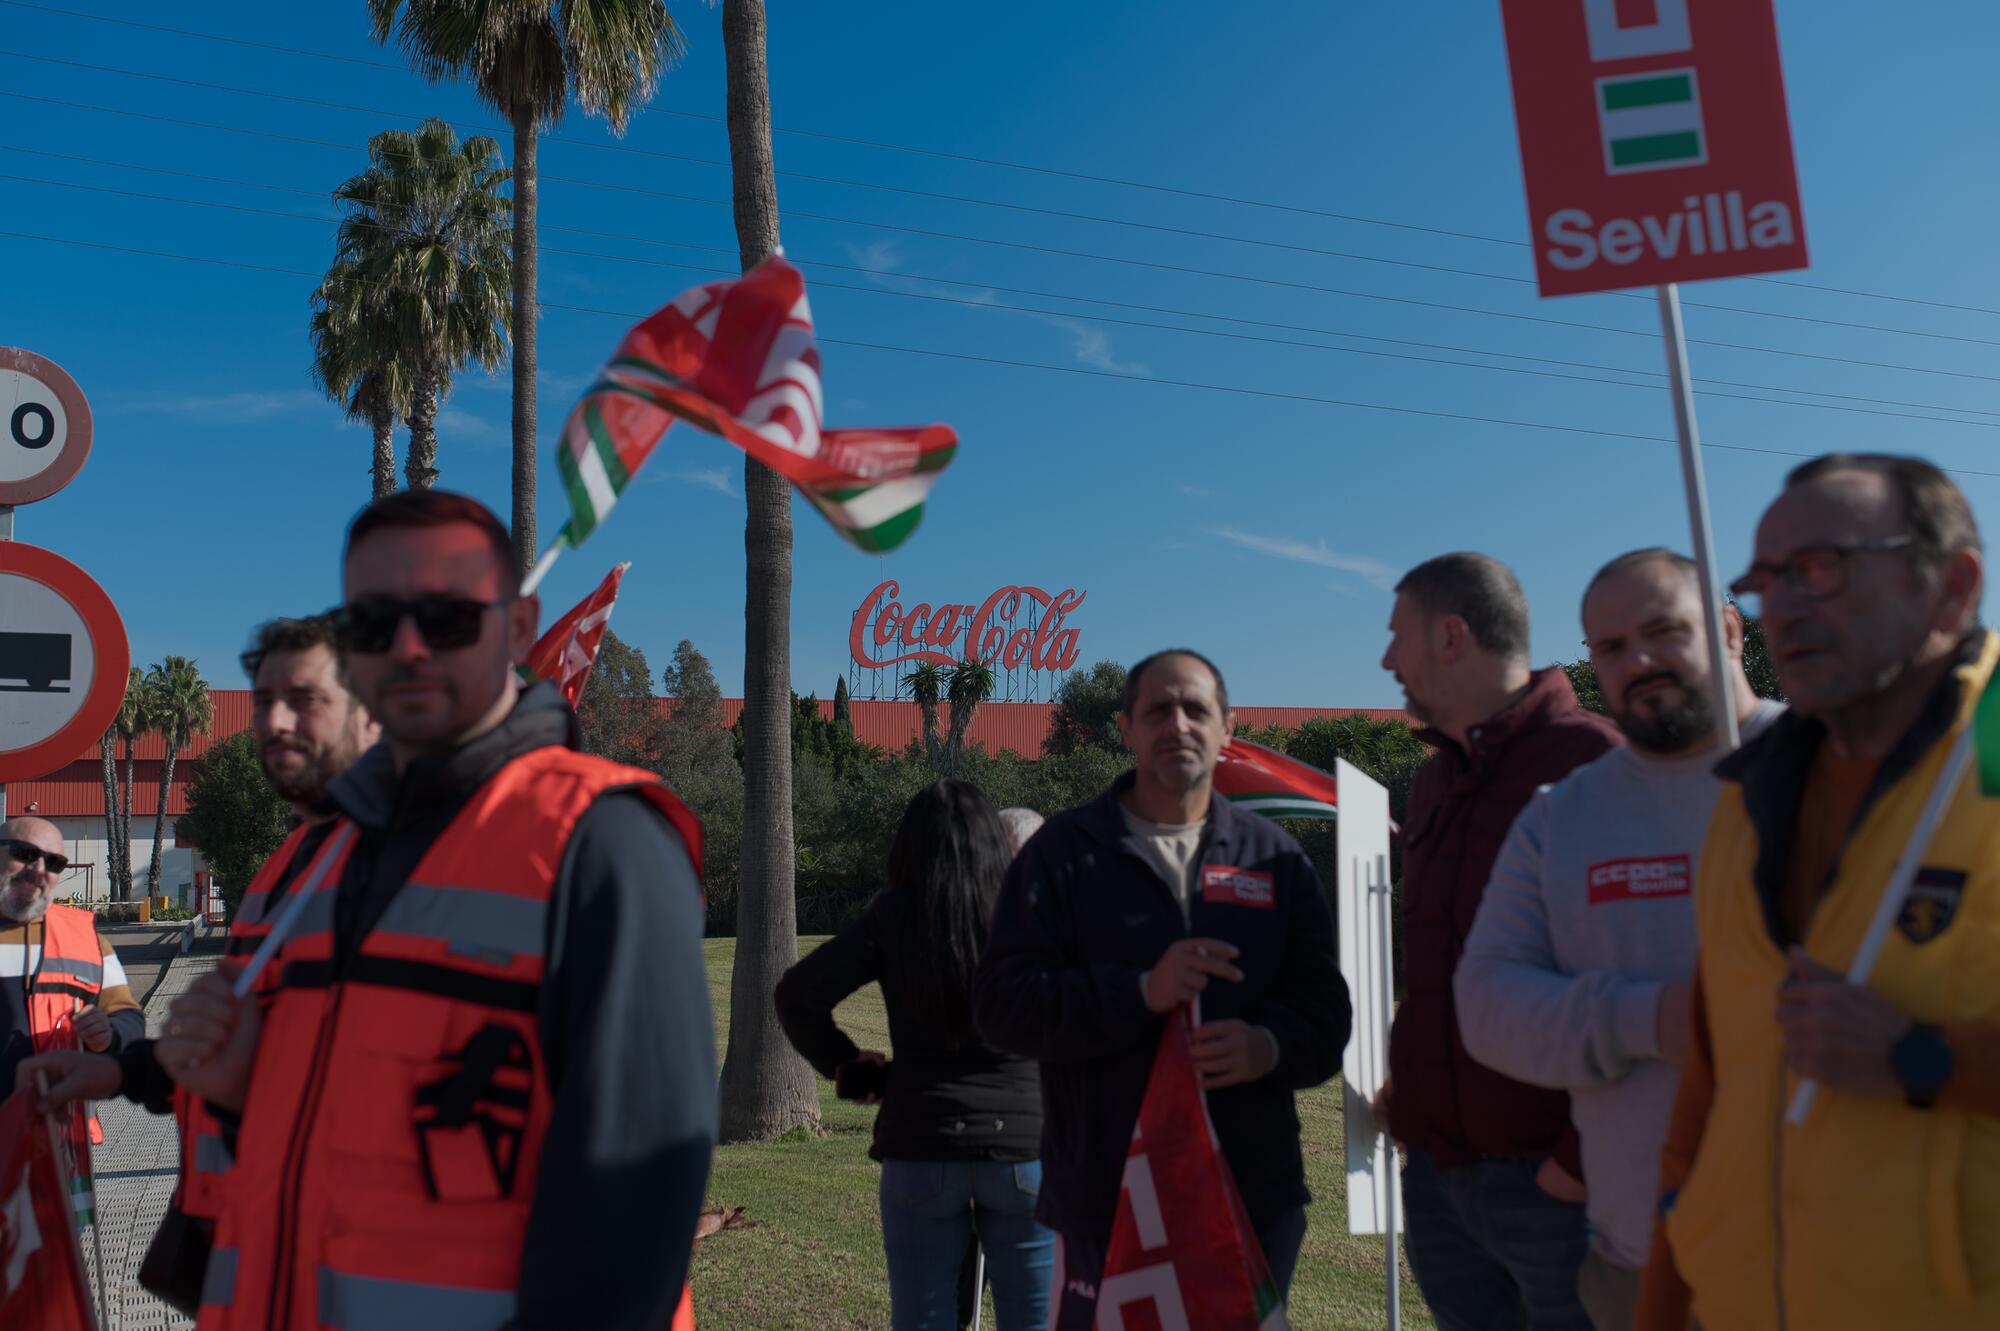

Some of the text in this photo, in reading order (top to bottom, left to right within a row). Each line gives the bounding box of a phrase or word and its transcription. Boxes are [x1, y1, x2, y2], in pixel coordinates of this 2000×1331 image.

[1545, 191, 1794, 270] Sevilla
[849, 579, 1087, 671] Coca-Cola
[1592, 863, 1667, 885] CCOO
